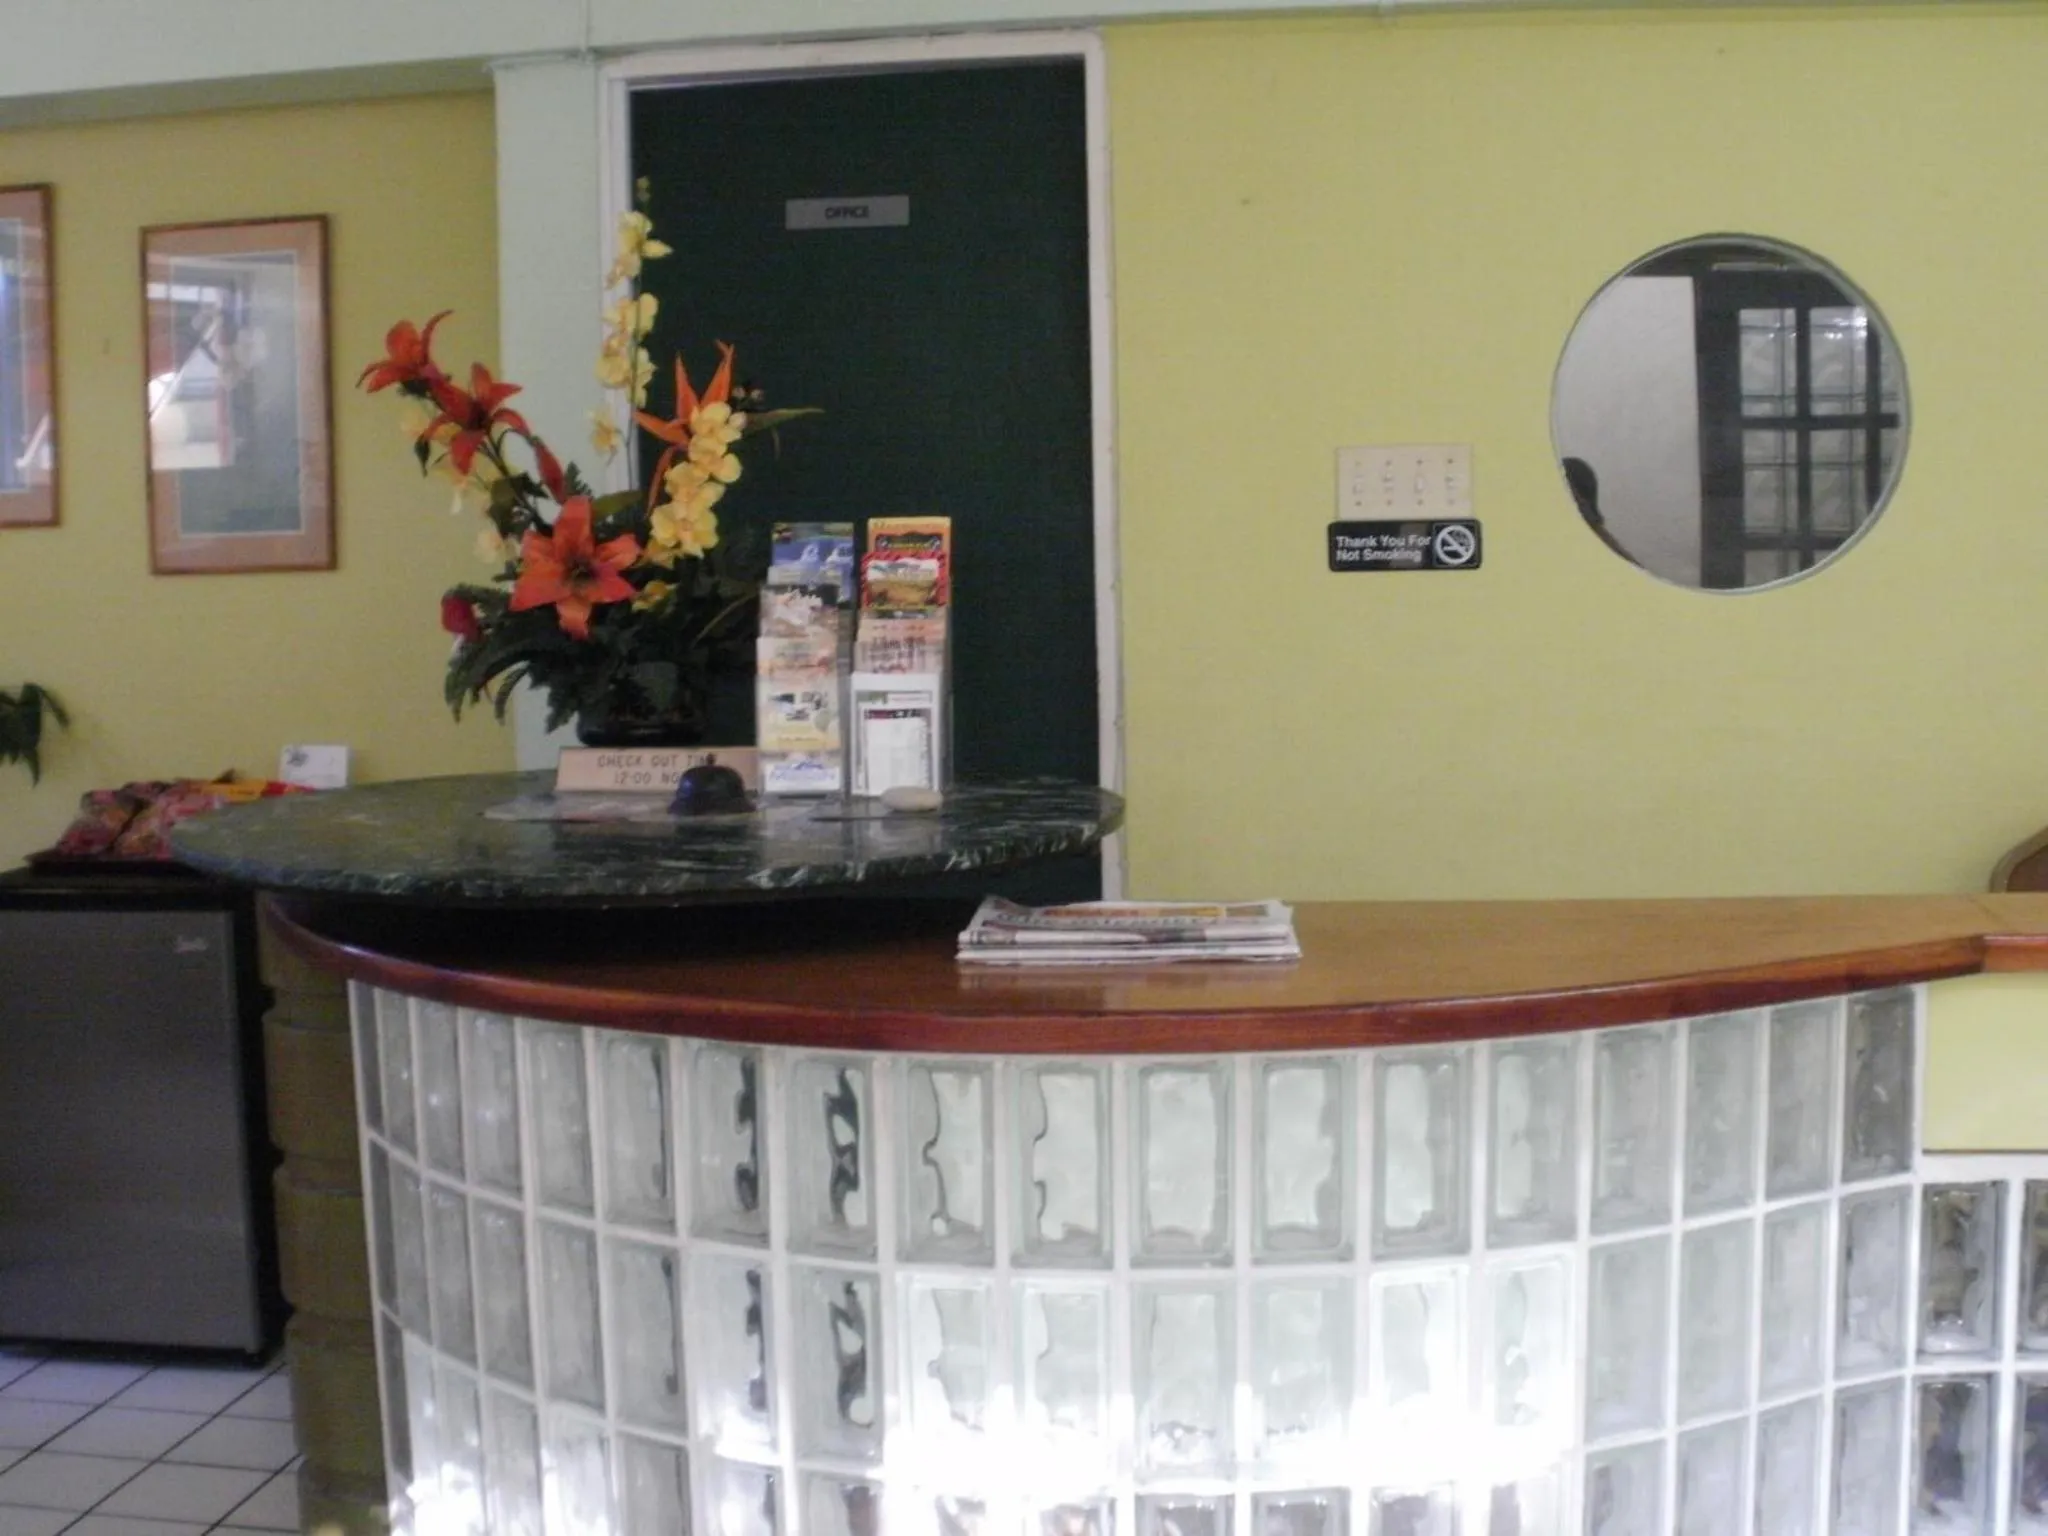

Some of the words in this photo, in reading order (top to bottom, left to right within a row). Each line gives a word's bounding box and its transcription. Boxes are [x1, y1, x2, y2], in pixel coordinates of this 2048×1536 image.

[825, 205, 870, 219] OFFICE
[1336, 536, 1377, 547] Thank
[1380, 535, 1406, 547] You
[1408, 535, 1432, 546] For
[1336, 549, 1360, 561] Not
[1363, 548, 1422, 562] Smoking
[598, 754, 643, 767] CHECK
[651, 754, 679, 766] OUT
